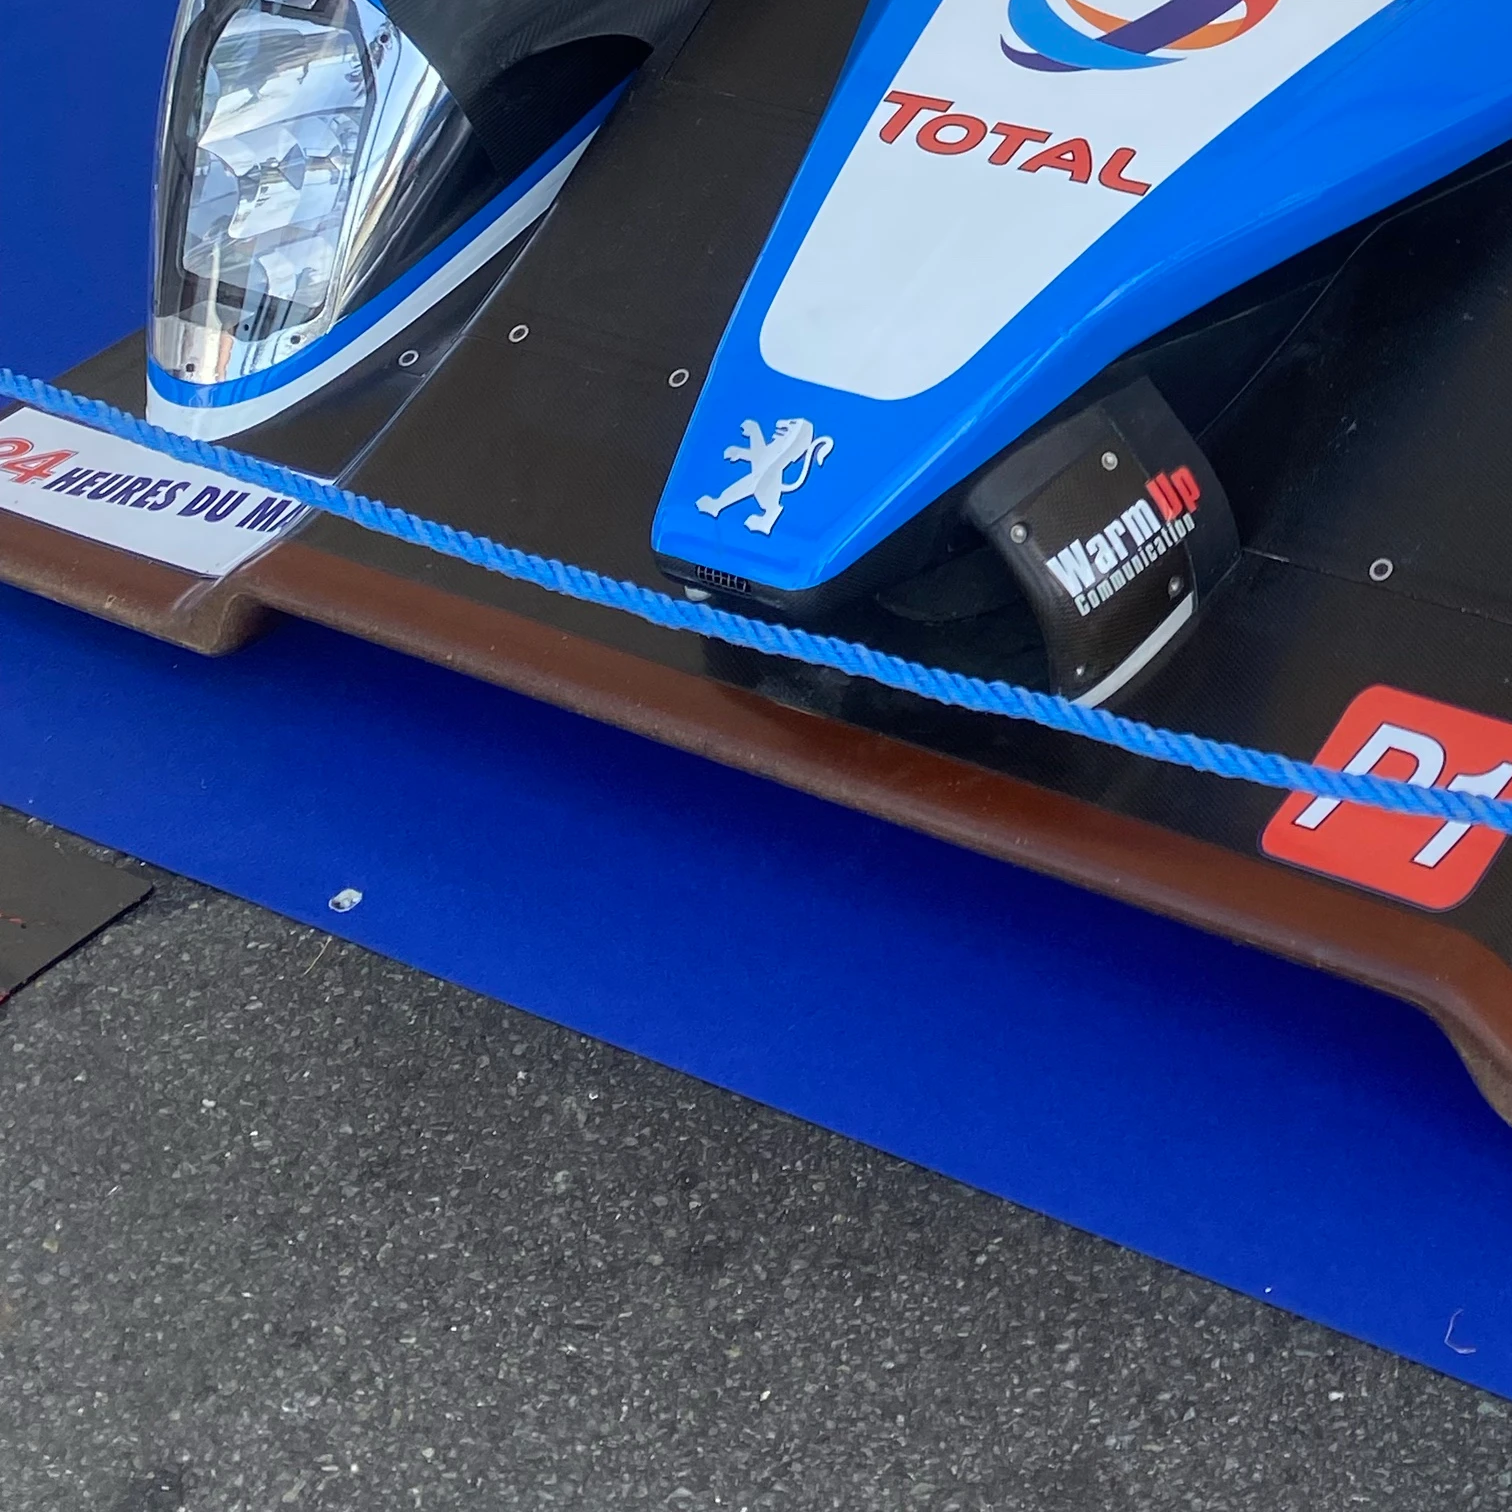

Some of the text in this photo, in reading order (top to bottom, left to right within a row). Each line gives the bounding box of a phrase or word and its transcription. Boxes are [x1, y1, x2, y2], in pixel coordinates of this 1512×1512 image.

[877, 90, 1152, 197] TOTAL
[42, 467, 191, 512] HEURES
[180, 486, 250, 523] DU
